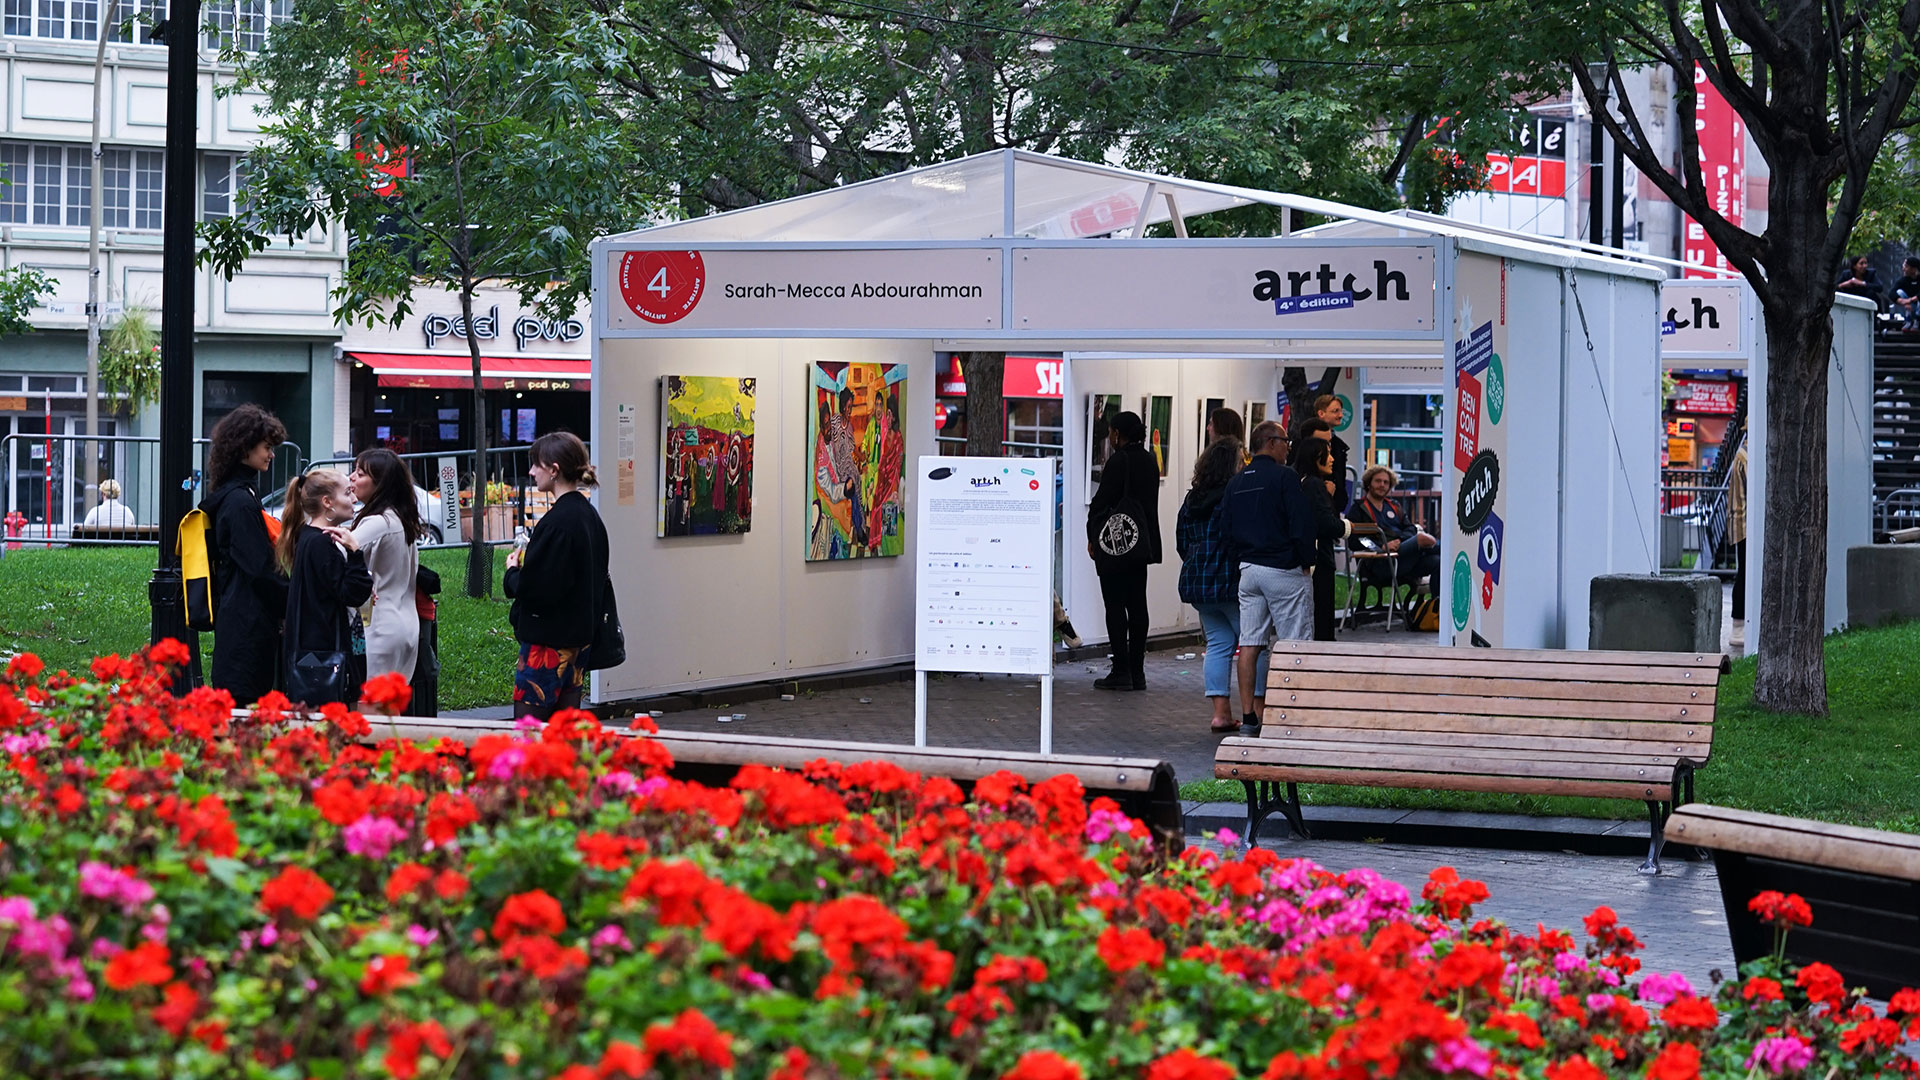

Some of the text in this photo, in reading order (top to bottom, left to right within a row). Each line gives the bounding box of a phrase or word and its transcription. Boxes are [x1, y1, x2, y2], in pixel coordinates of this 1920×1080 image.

[1716, 165, 1729, 217] PIZZ
[647, 266, 671, 299] 4
[724, 282, 983, 299] Sarah-Mecca Abdourahman
[1252, 260, 1410, 301] artch
[1299, 297, 1349, 309] édition
[424, 305, 501, 349] peel
[551, 381, 571, 391] pub
[1035, 362, 1064, 395] SH
[1461, 389, 1476, 415] REN
[1459, 410, 1476, 436] CON
[1459, 433, 1474, 458] TRE
[970, 476, 1001, 486] artch
[1464, 466, 1493, 517] artch
[444, 480, 457, 530] Montréal
